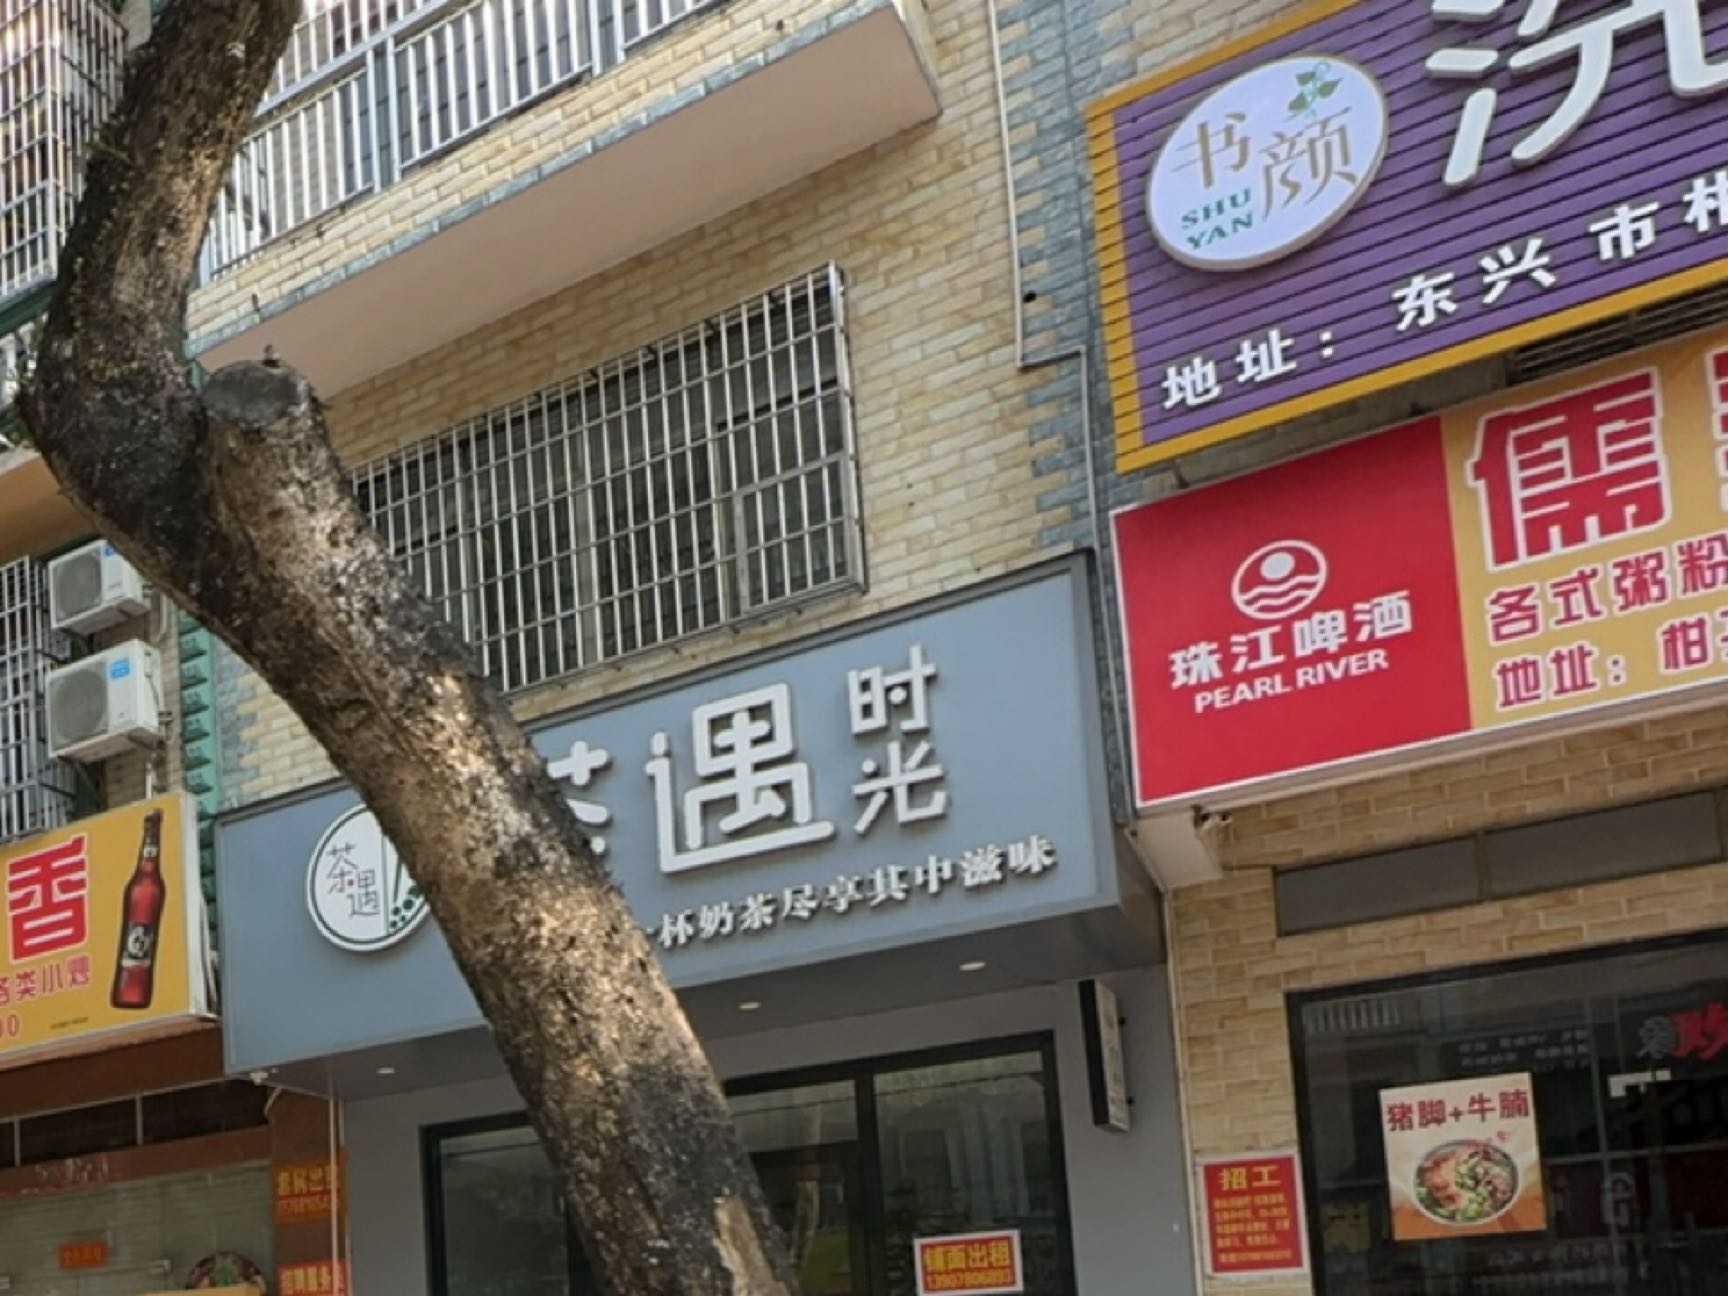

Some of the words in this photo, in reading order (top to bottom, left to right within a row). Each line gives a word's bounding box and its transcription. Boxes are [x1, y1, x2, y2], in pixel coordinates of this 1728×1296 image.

[1181, 188, 1252, 231] SHU
[1186, 213, 1254, 250] YAN
[1169, 589, 1413, 690] 珠江啤酒
[1194, 674, 1291, 714] PEARL
[1296, 648, 1389, 689] RIVER
[848, 643, 950, 835] 时光
[1386, 1087, 1530, 1132] 猪脚+牛腩
[1217, 1164, 1281, 1191] 招工
